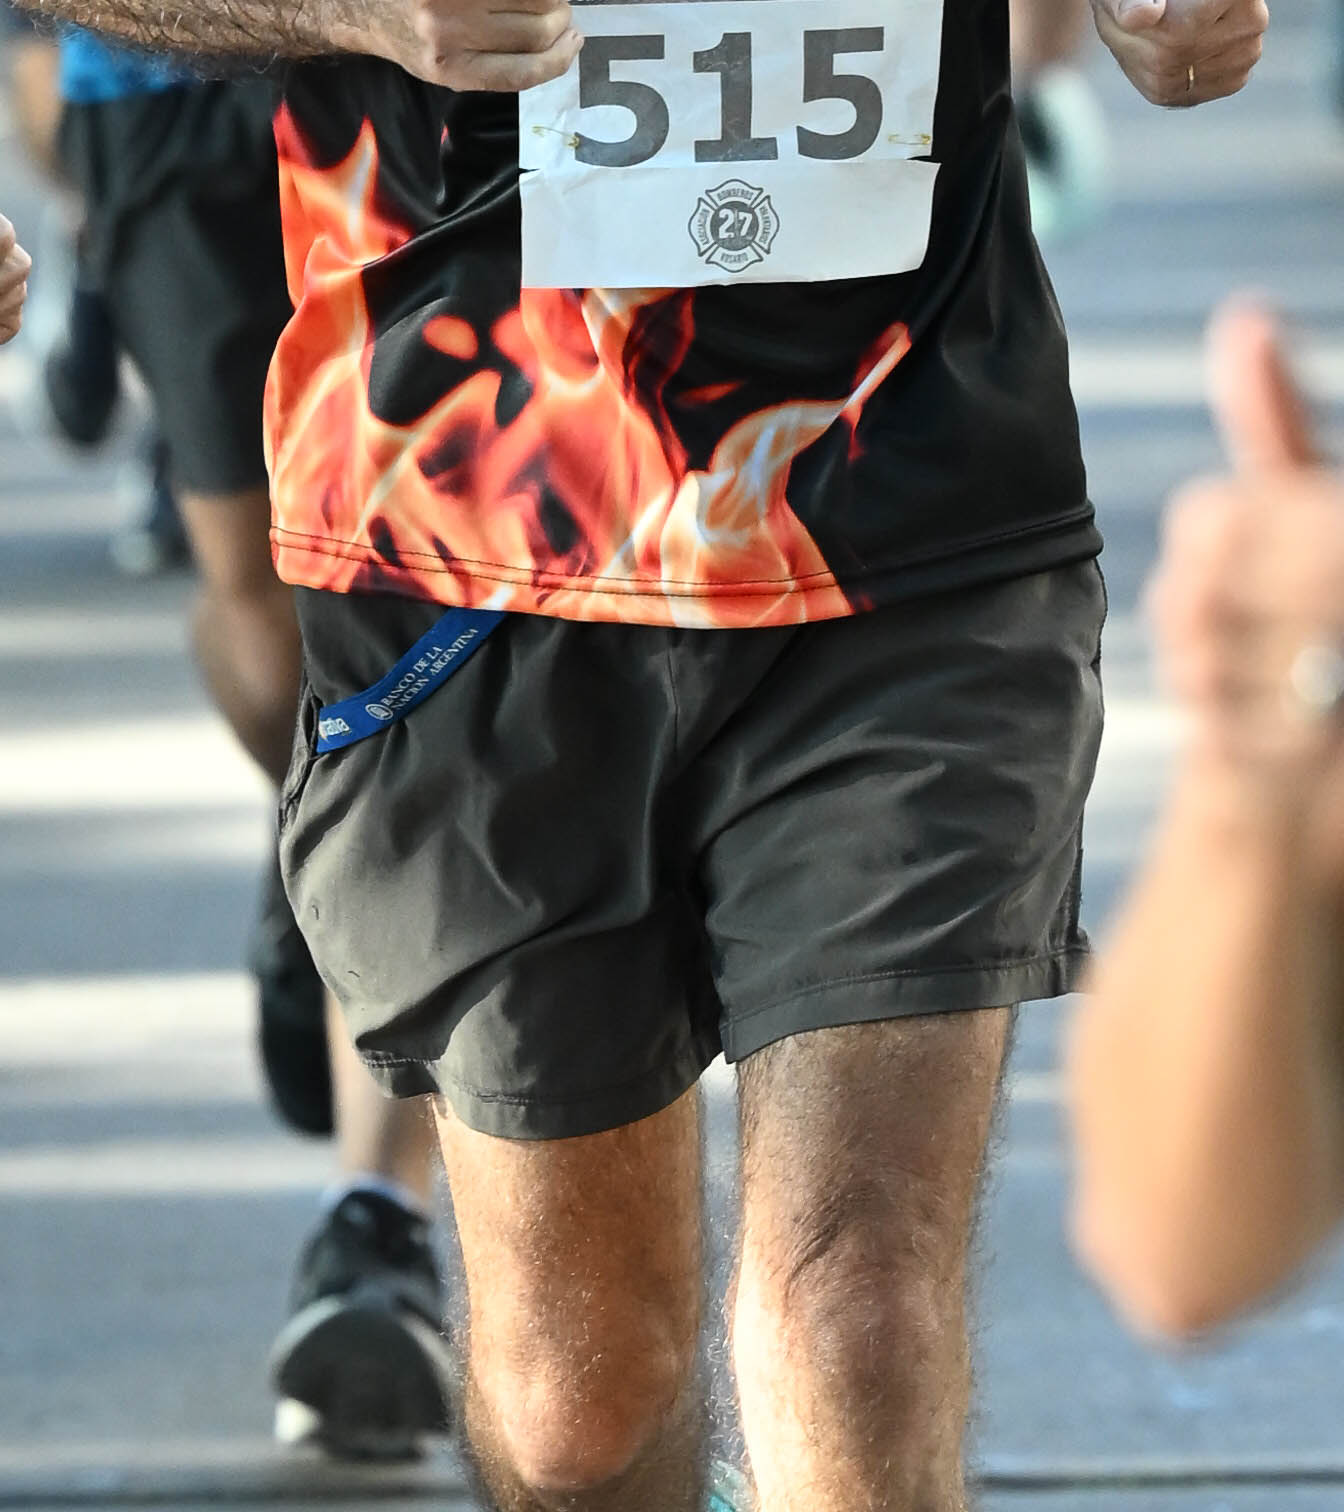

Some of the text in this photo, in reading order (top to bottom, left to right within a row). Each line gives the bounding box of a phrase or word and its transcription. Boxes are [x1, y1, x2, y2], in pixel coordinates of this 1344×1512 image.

[574, 26, 885, 168] 515
[718, 208, 753, 239] 27
[381, 645, 443, 706] BANCO DE LA
[429, 628, 479, 676] ARGENTINA
